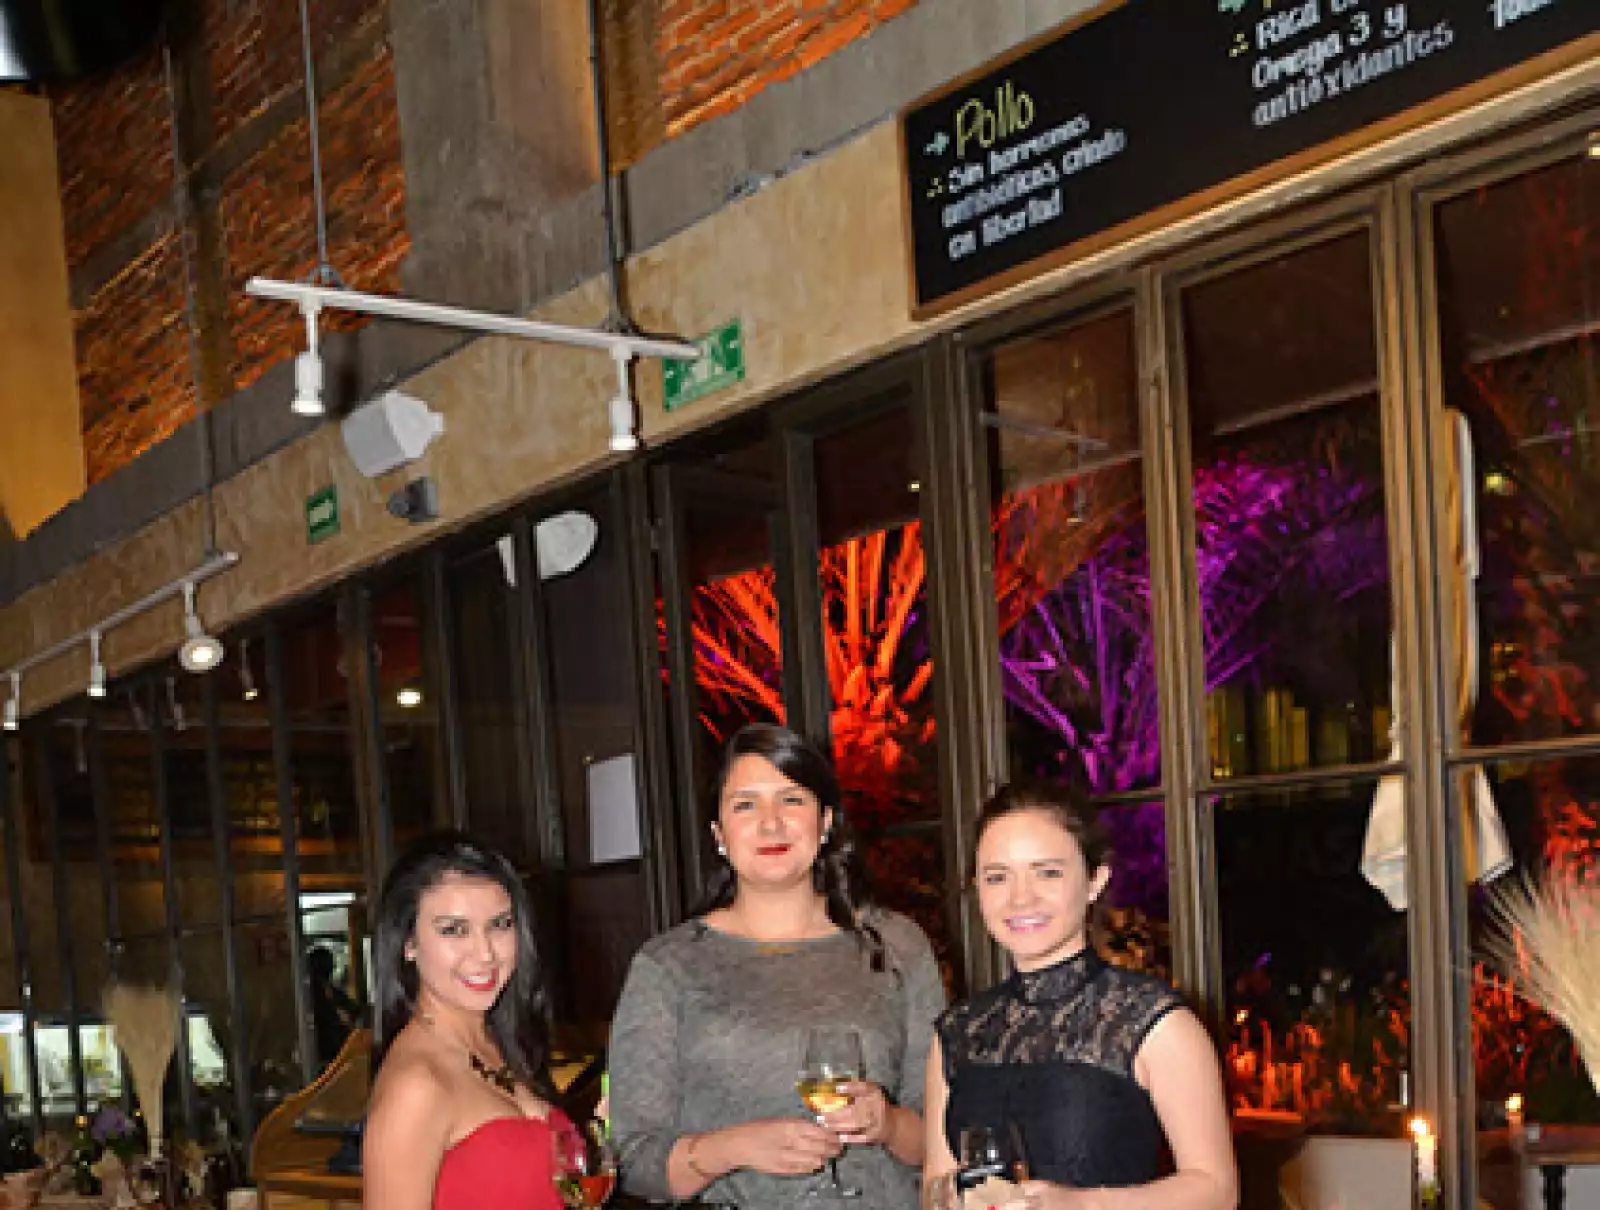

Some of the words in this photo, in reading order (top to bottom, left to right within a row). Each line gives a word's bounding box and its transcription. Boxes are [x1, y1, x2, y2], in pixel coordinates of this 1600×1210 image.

[1252, 31, 1343, 88] Omega
[1349, 11, 1371, 46] 3
[956, 79, 1035, 159] Pollo
[948, 162, 985, 194] Sin
